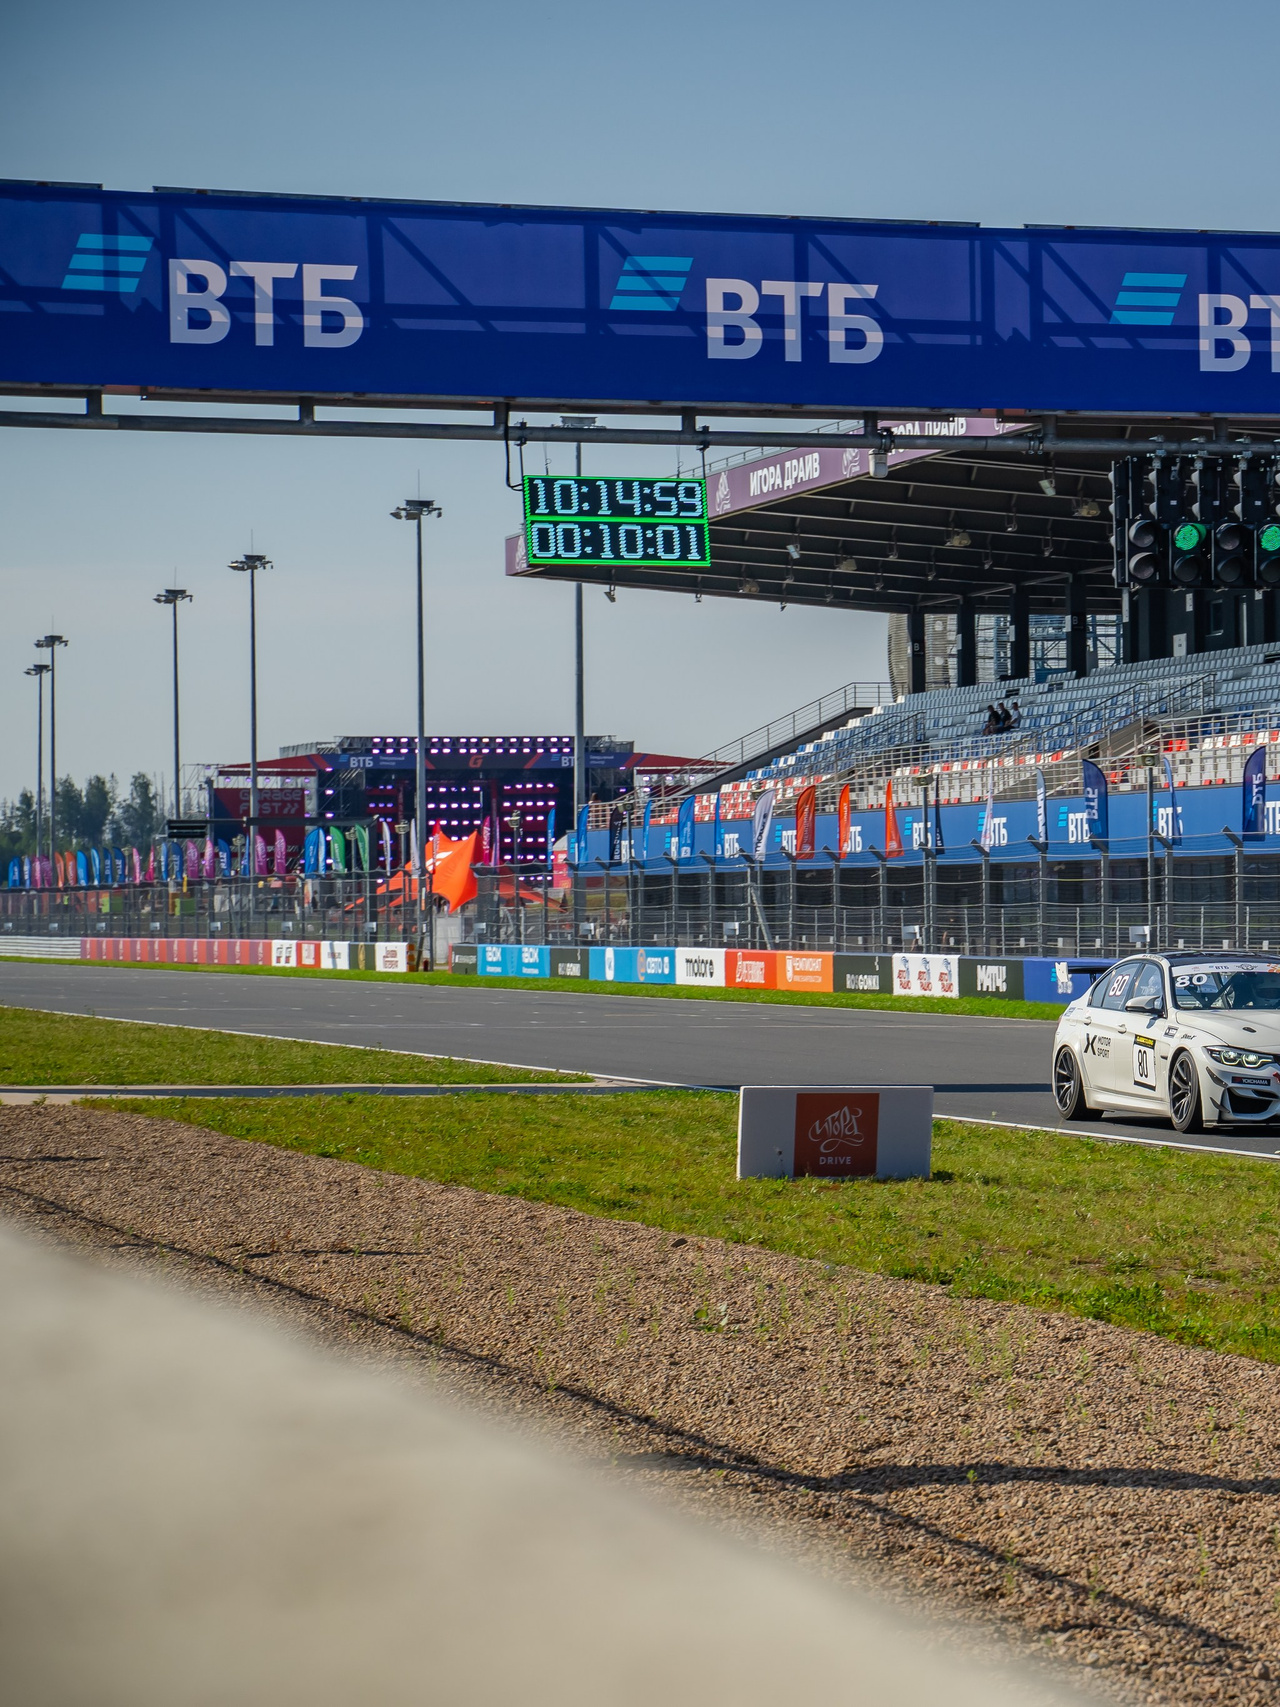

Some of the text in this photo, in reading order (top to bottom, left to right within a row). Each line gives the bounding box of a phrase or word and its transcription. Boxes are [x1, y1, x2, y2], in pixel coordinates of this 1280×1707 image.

[168, 258, 364, 348] ВТБ
[705, 278, 884, 364] ВТБ
[750, 464, 783, 496] ИГОРА
[533, 479, 702, 516] 10:14:59
[531, 522, 701, 560] 00:10:01
[350, 757, 373, 768] ВТБ
[561, 756, 575, 767] ВТ
[1109, 974, 1130, 997] 80
[1175, 974, 1208, 988] 80
[1097, 1036, 1111, 1047] MOTOR
[1097, 1048, 1110, 1058] SPORT
[1137, 1049, 1148, 1078] 80
[819, 1156, 852, 1165] DRIVE
